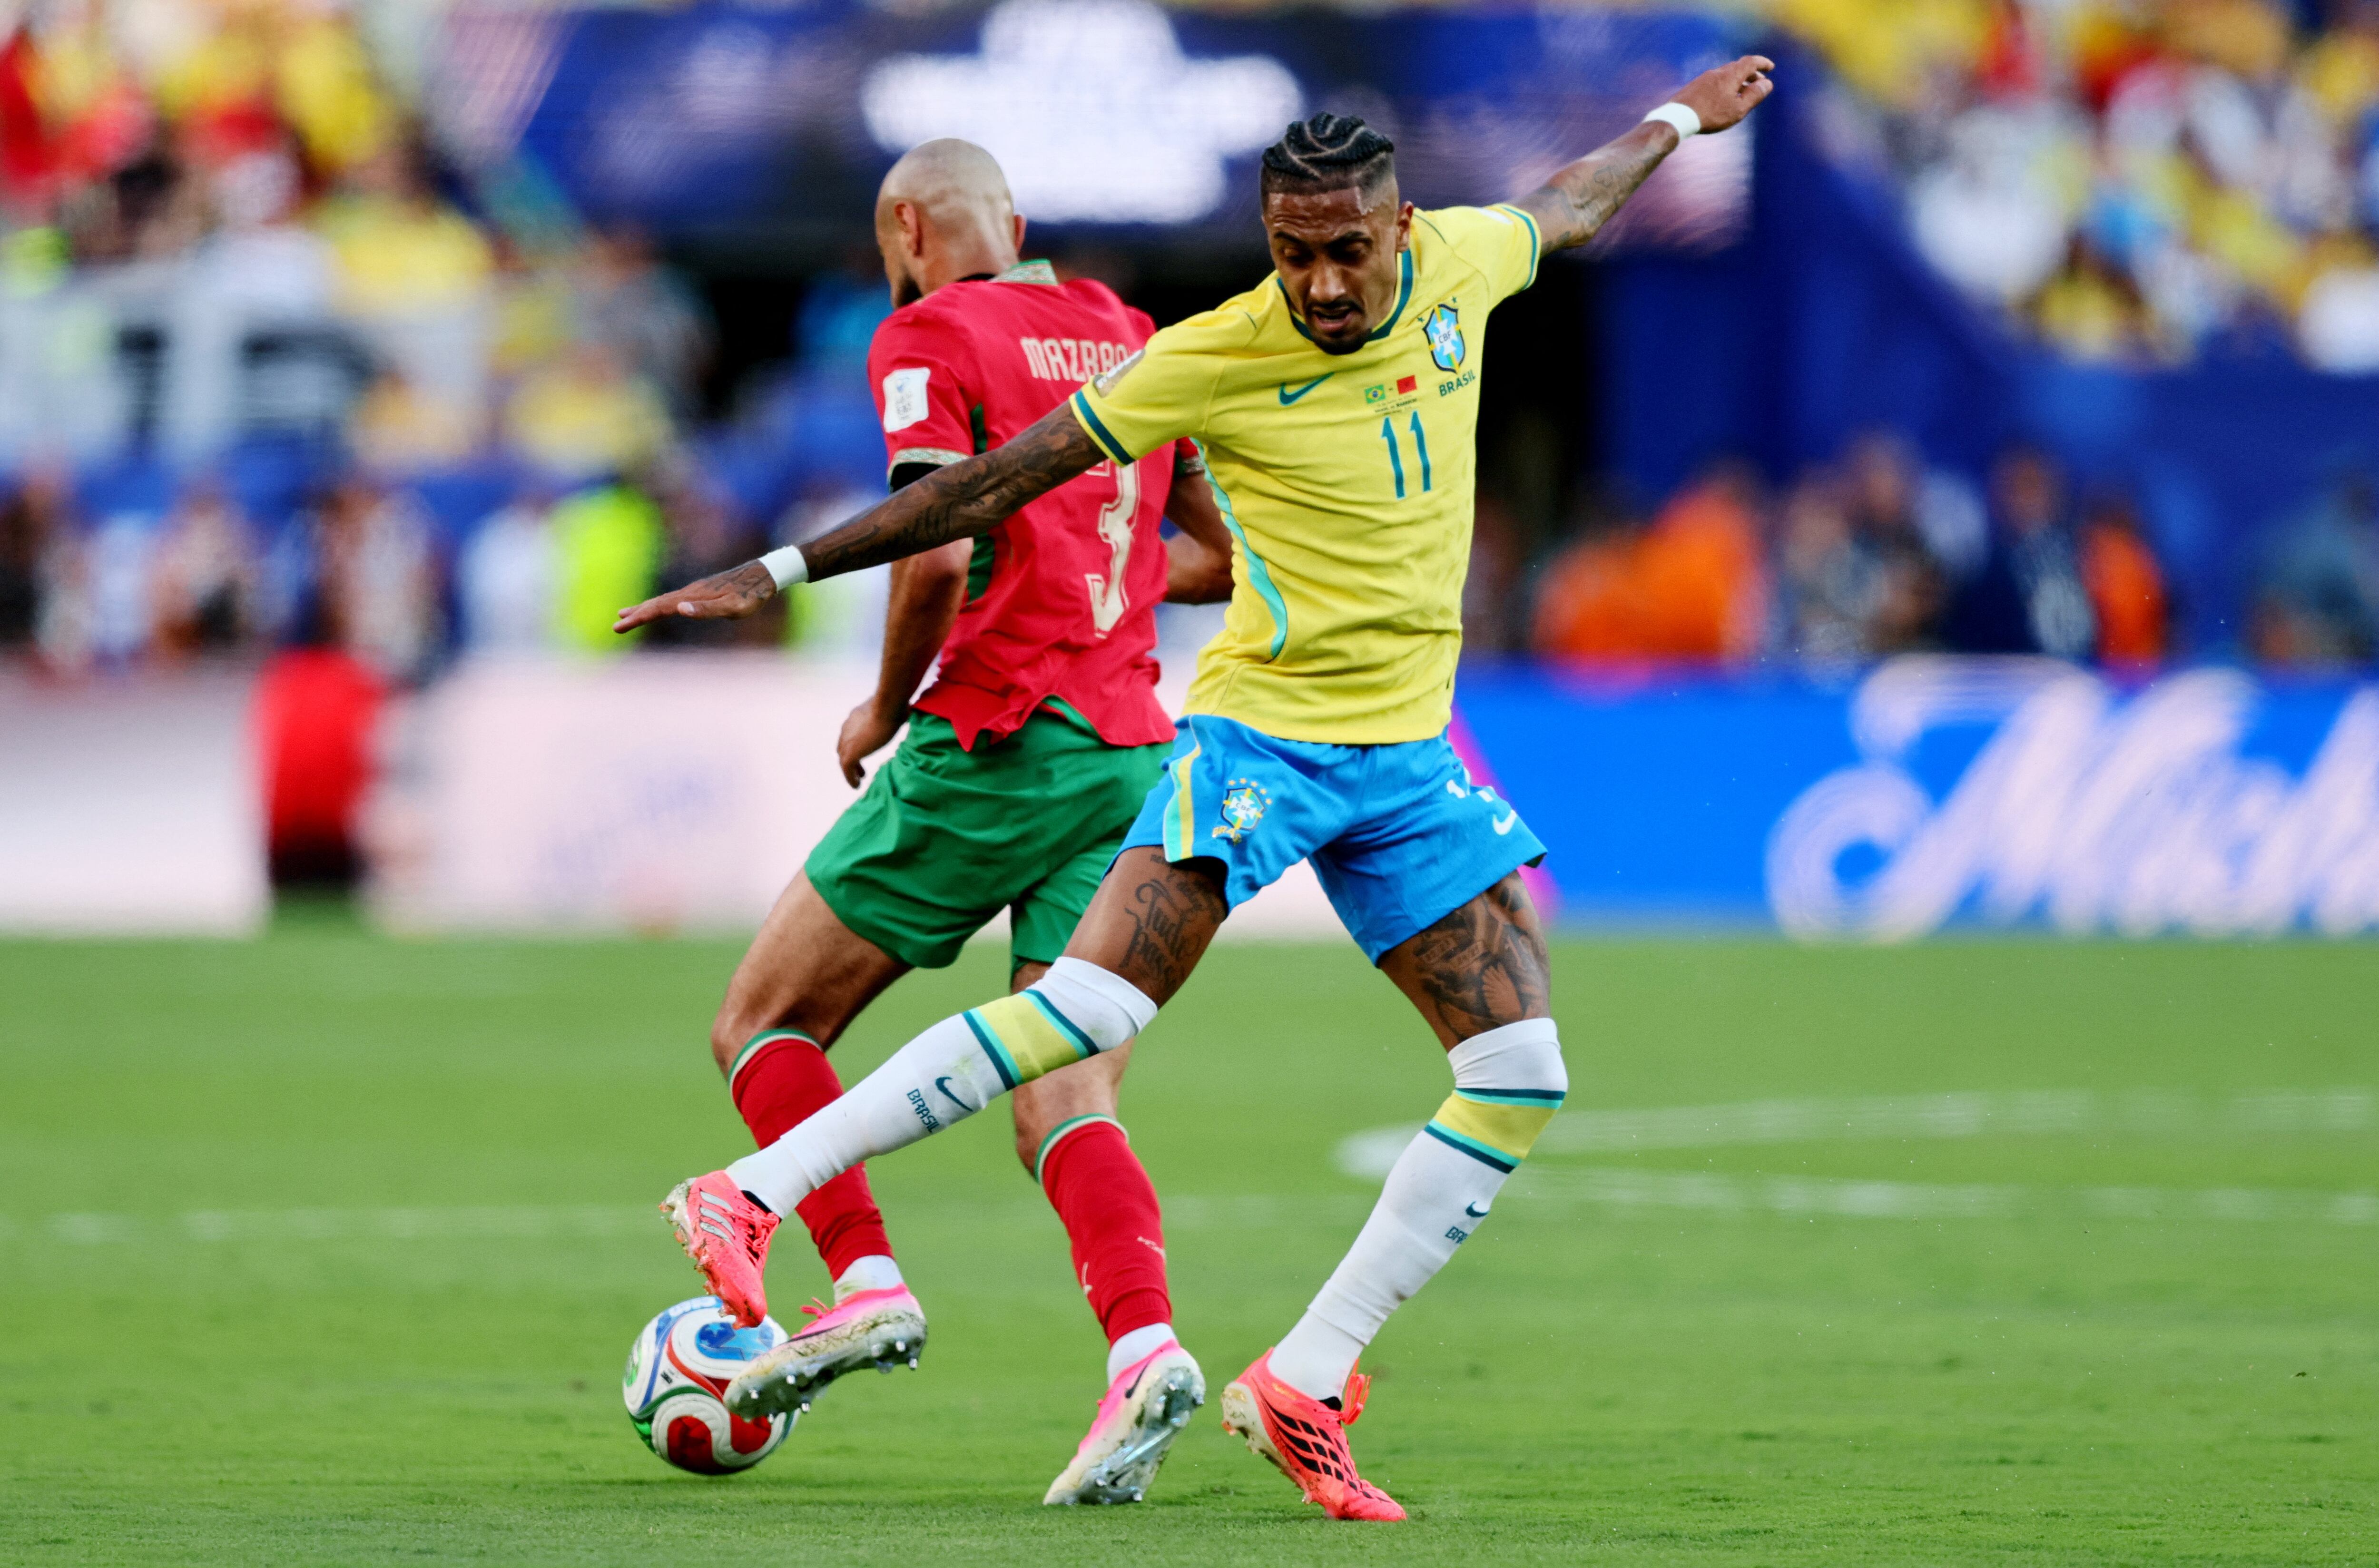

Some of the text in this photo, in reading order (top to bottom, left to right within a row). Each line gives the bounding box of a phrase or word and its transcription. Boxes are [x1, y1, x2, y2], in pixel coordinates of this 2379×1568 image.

[1438, 330, 1451, 343] CBF
[1439, 369, 1476, 397] BRASIL
[1381, 411, 1432, 499] 11
[907, 1088, 940, 1133] BRASIL
